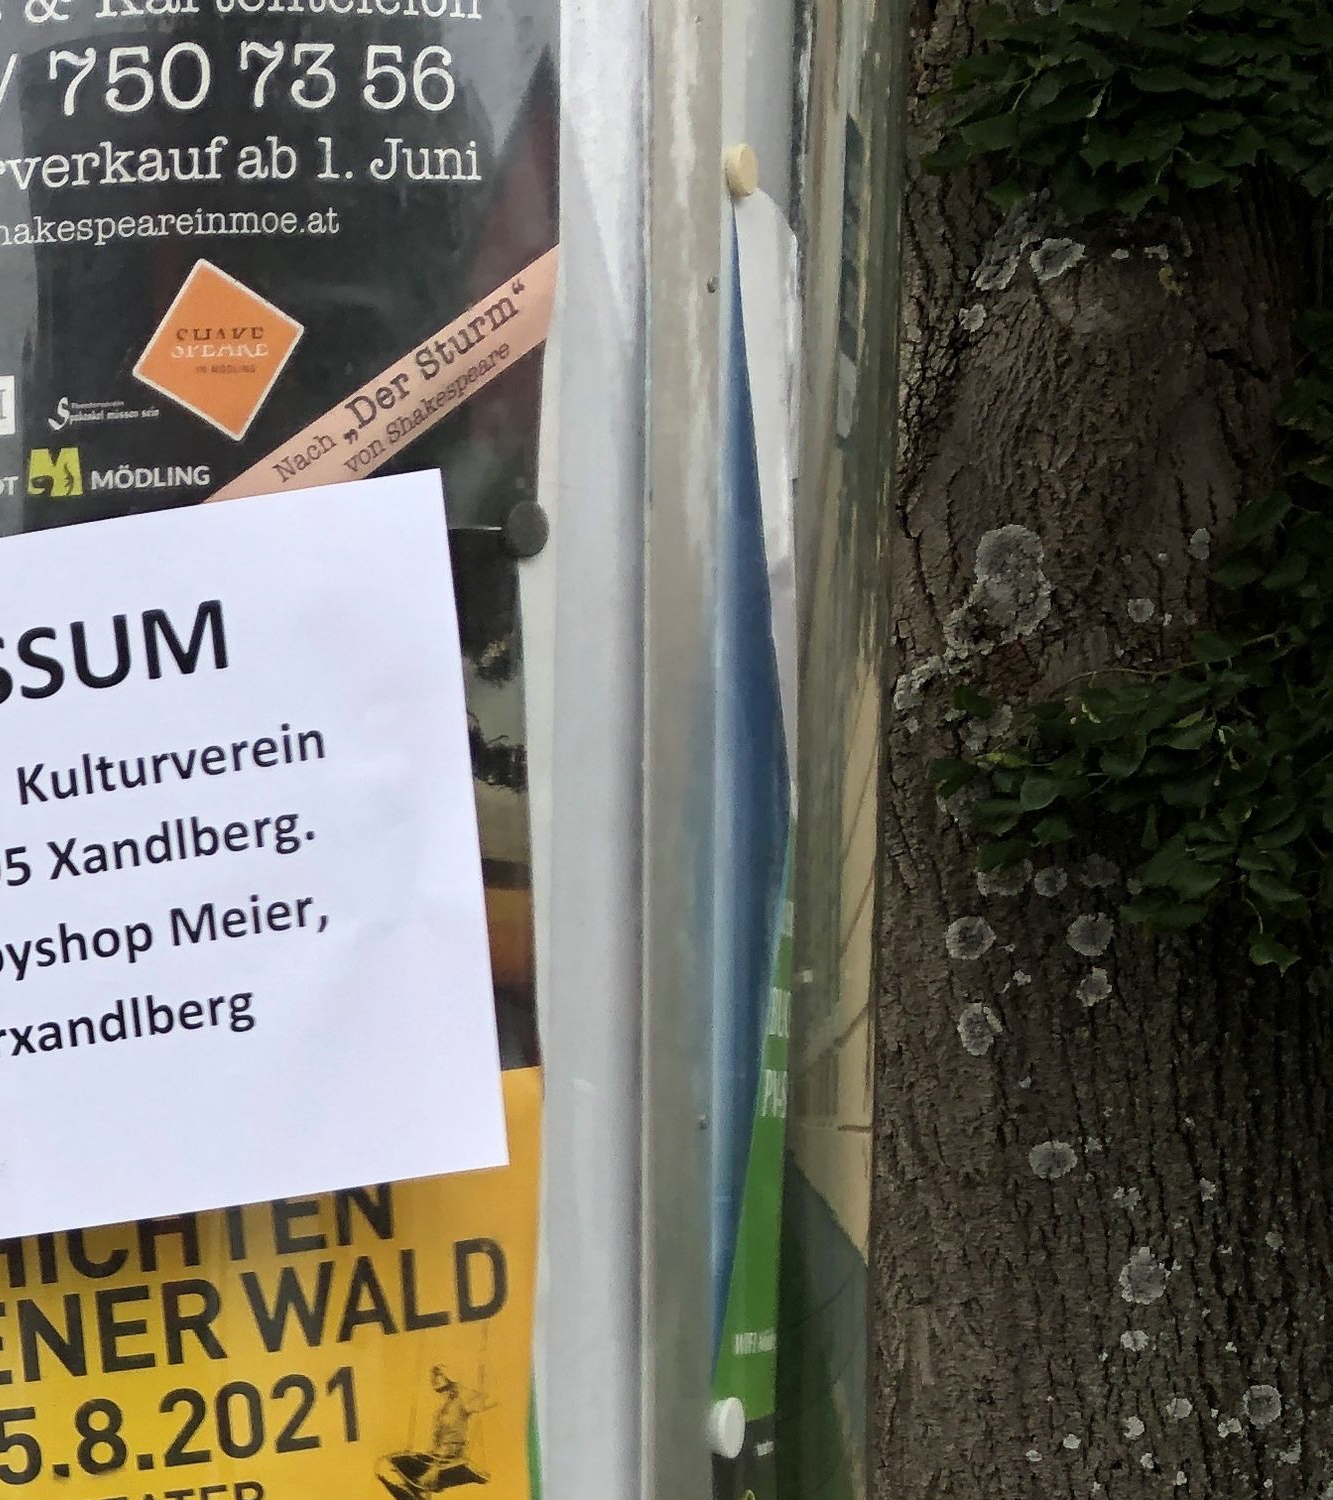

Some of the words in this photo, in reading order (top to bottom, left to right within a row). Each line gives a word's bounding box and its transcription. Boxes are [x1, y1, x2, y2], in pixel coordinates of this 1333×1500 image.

[49, 41, 211, 117] 750
[239, 40, 337, 108] 73
[362, 45, 456, 111] 56
[237, 136, 297, 180] ab
[317, 136, 354, 180] 1.
[369, 137, 482, 181] Juni
[342, 437, 387, 474] von
[385, 340, 511, 444] Shakespeare
[90, 463, 212, 491] MÖDLING
[271, 431, 338, 483] Nach
[16, 722, 326, 805] Kulturverein
[46, 812, 317, 881] Xandlberg.
[169, 893, 330, 947] Meier,
[239, 1238, 508, 1353] WALD
